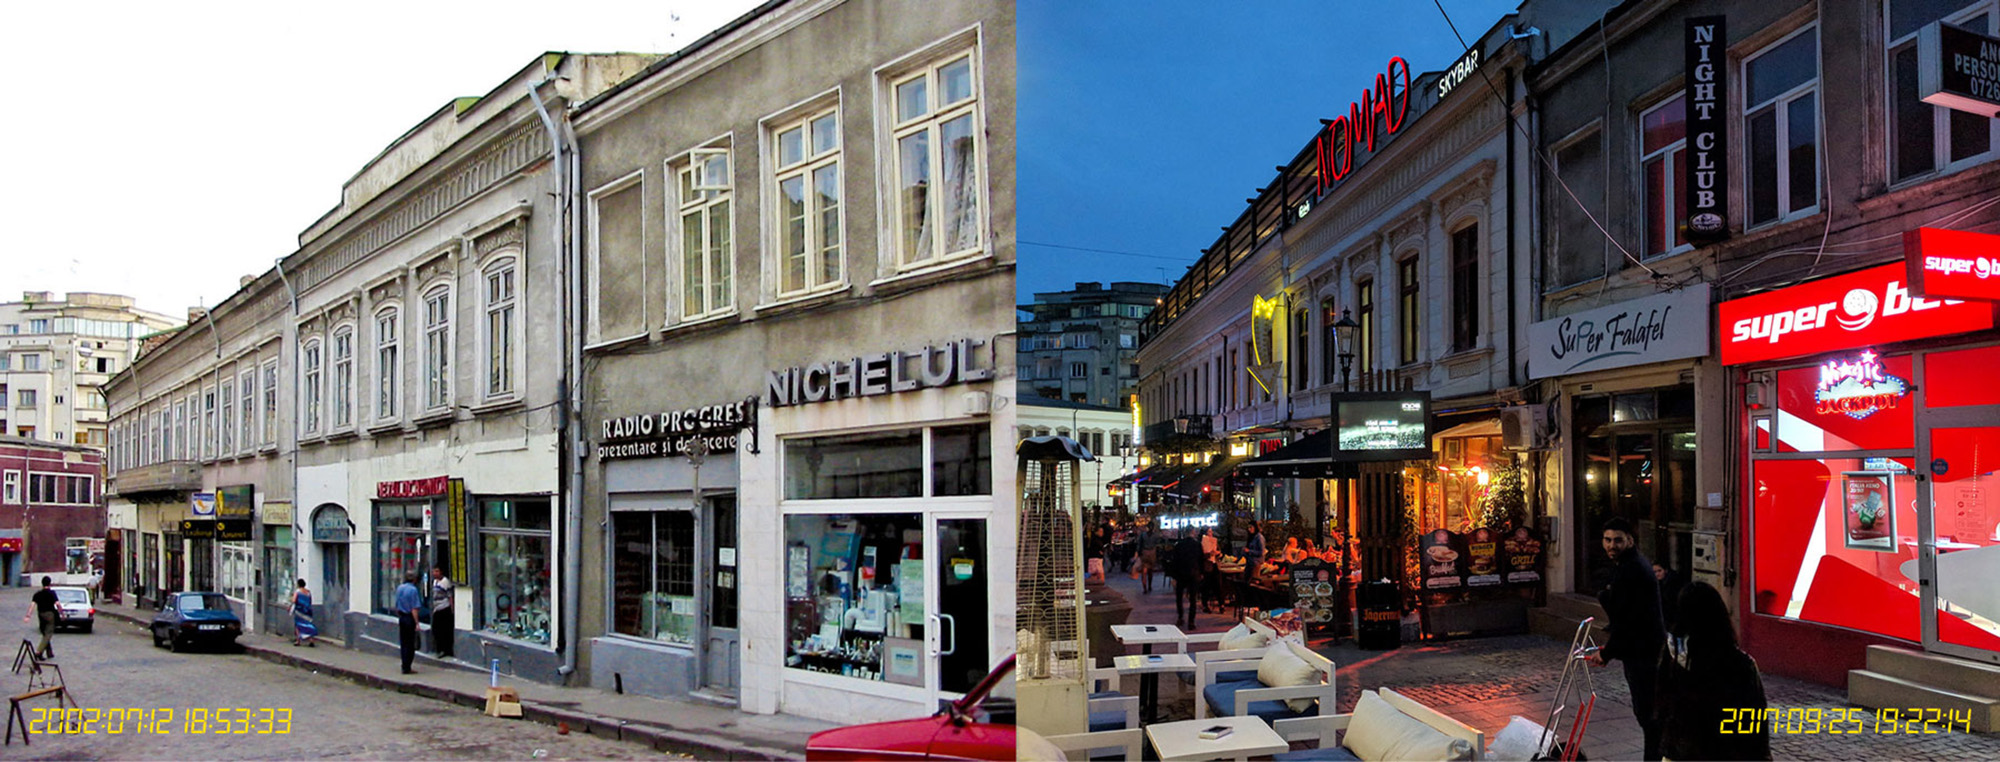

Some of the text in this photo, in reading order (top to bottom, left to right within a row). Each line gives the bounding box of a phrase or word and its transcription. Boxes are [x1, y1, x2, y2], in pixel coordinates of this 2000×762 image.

[1438, 48, 1479, 98] SKYBAR
[1694, 25, 1716, 120] NIGHT
[1979, 41, 2000, 62] AN
[1316, 55, 1408, 197] NOMAD
[1695, 132, 1716, 208] CLUB
[1925, 254, 1974, 275] super
[1606, 305, 1672, 351] Falafel
[1731, 301, 1837, 344] super
[764, 337, 993, 407] NICHELUL
[1816, 393, 1901, 415] JACKPOT
[602, 415, 653, 439] RADIO
[598, 441, 657, 461] prezentare
